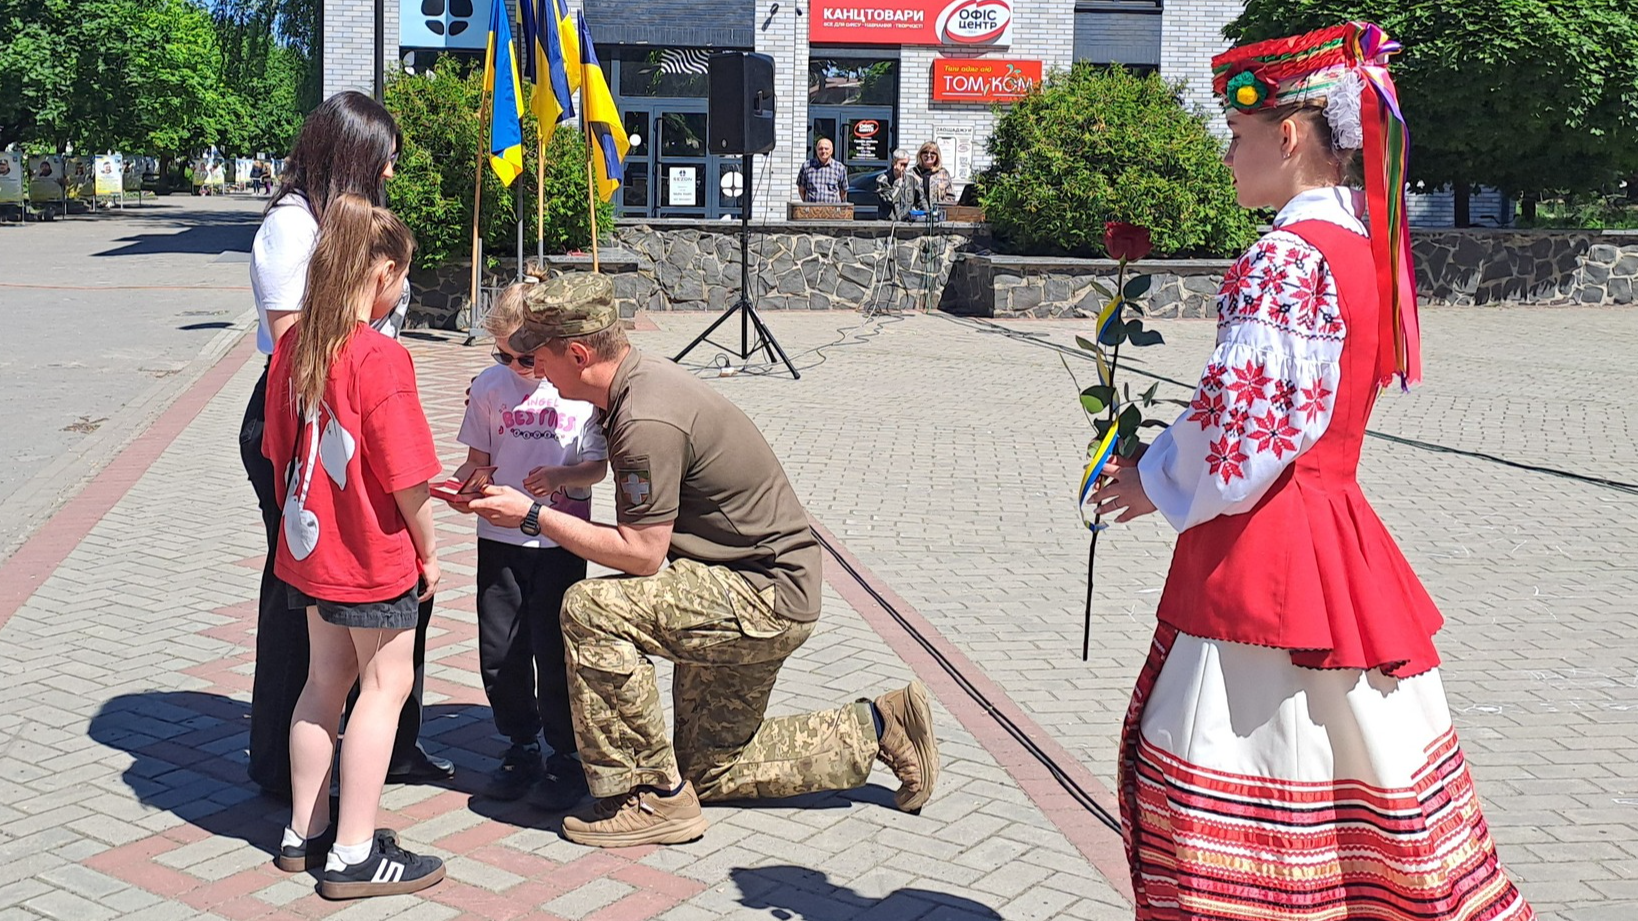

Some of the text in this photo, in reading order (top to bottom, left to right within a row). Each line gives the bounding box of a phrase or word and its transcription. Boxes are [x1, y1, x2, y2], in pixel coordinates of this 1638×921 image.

[823, 8, 924, 22] КАНЦТОВАРИ
[959, 9, 997, 20] ОФІС
[502, 408, 576, 432] BESTIES
